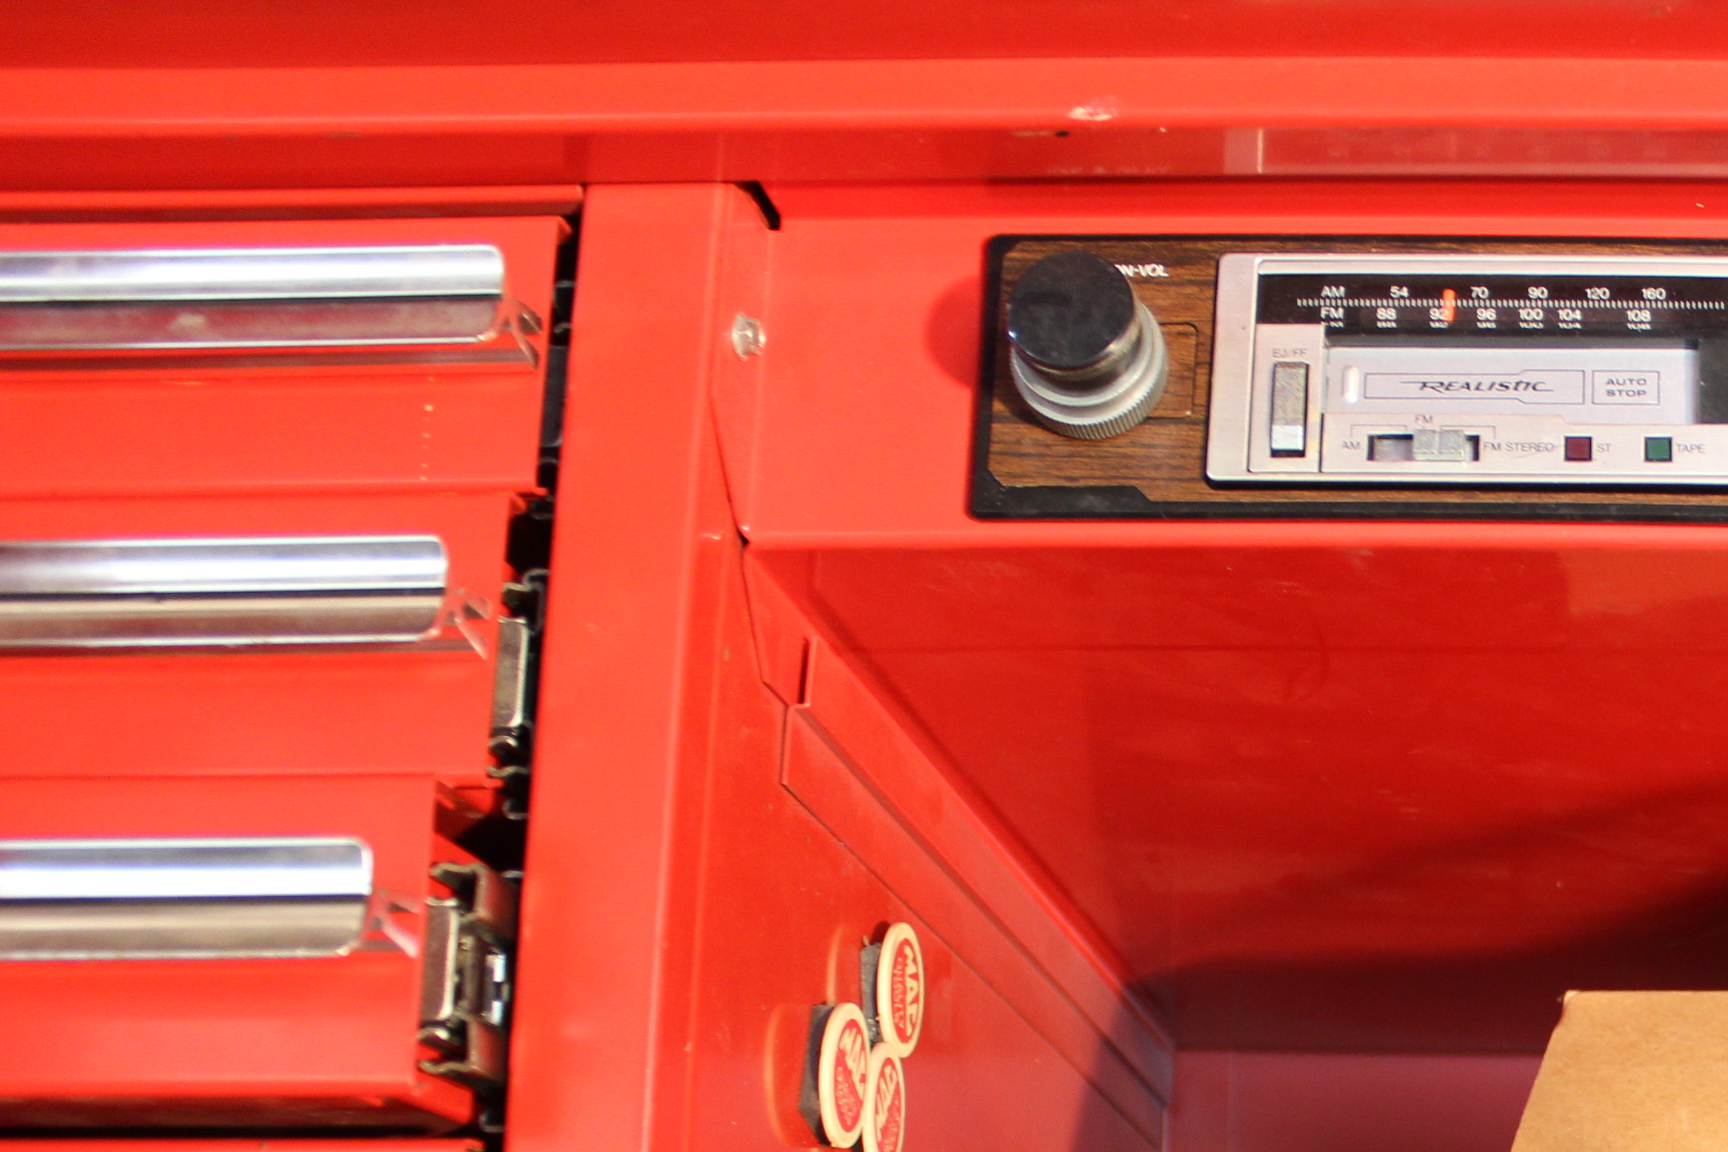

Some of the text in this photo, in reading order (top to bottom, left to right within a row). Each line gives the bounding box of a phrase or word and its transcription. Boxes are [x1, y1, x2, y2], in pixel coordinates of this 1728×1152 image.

[1113, 263, 1170, 278] N-VOL
[1320, 286, 1667, 301] AM 54 70 90 120 160
[1320, 307, 1651, 322] FM 88 92 96 100 104 108
[1605, 377, 1648, 387] AUTO
[1605, 389, 1647, 399] STOP
[1414, 414, 1434, 424] FM
[1341, 440, 1361, 450] AM
[1483, 441, 1554, 454] FM STEREO
[1597, 442, 1612, 453] ST
[1676, 442, 1706, 454] TAPE
